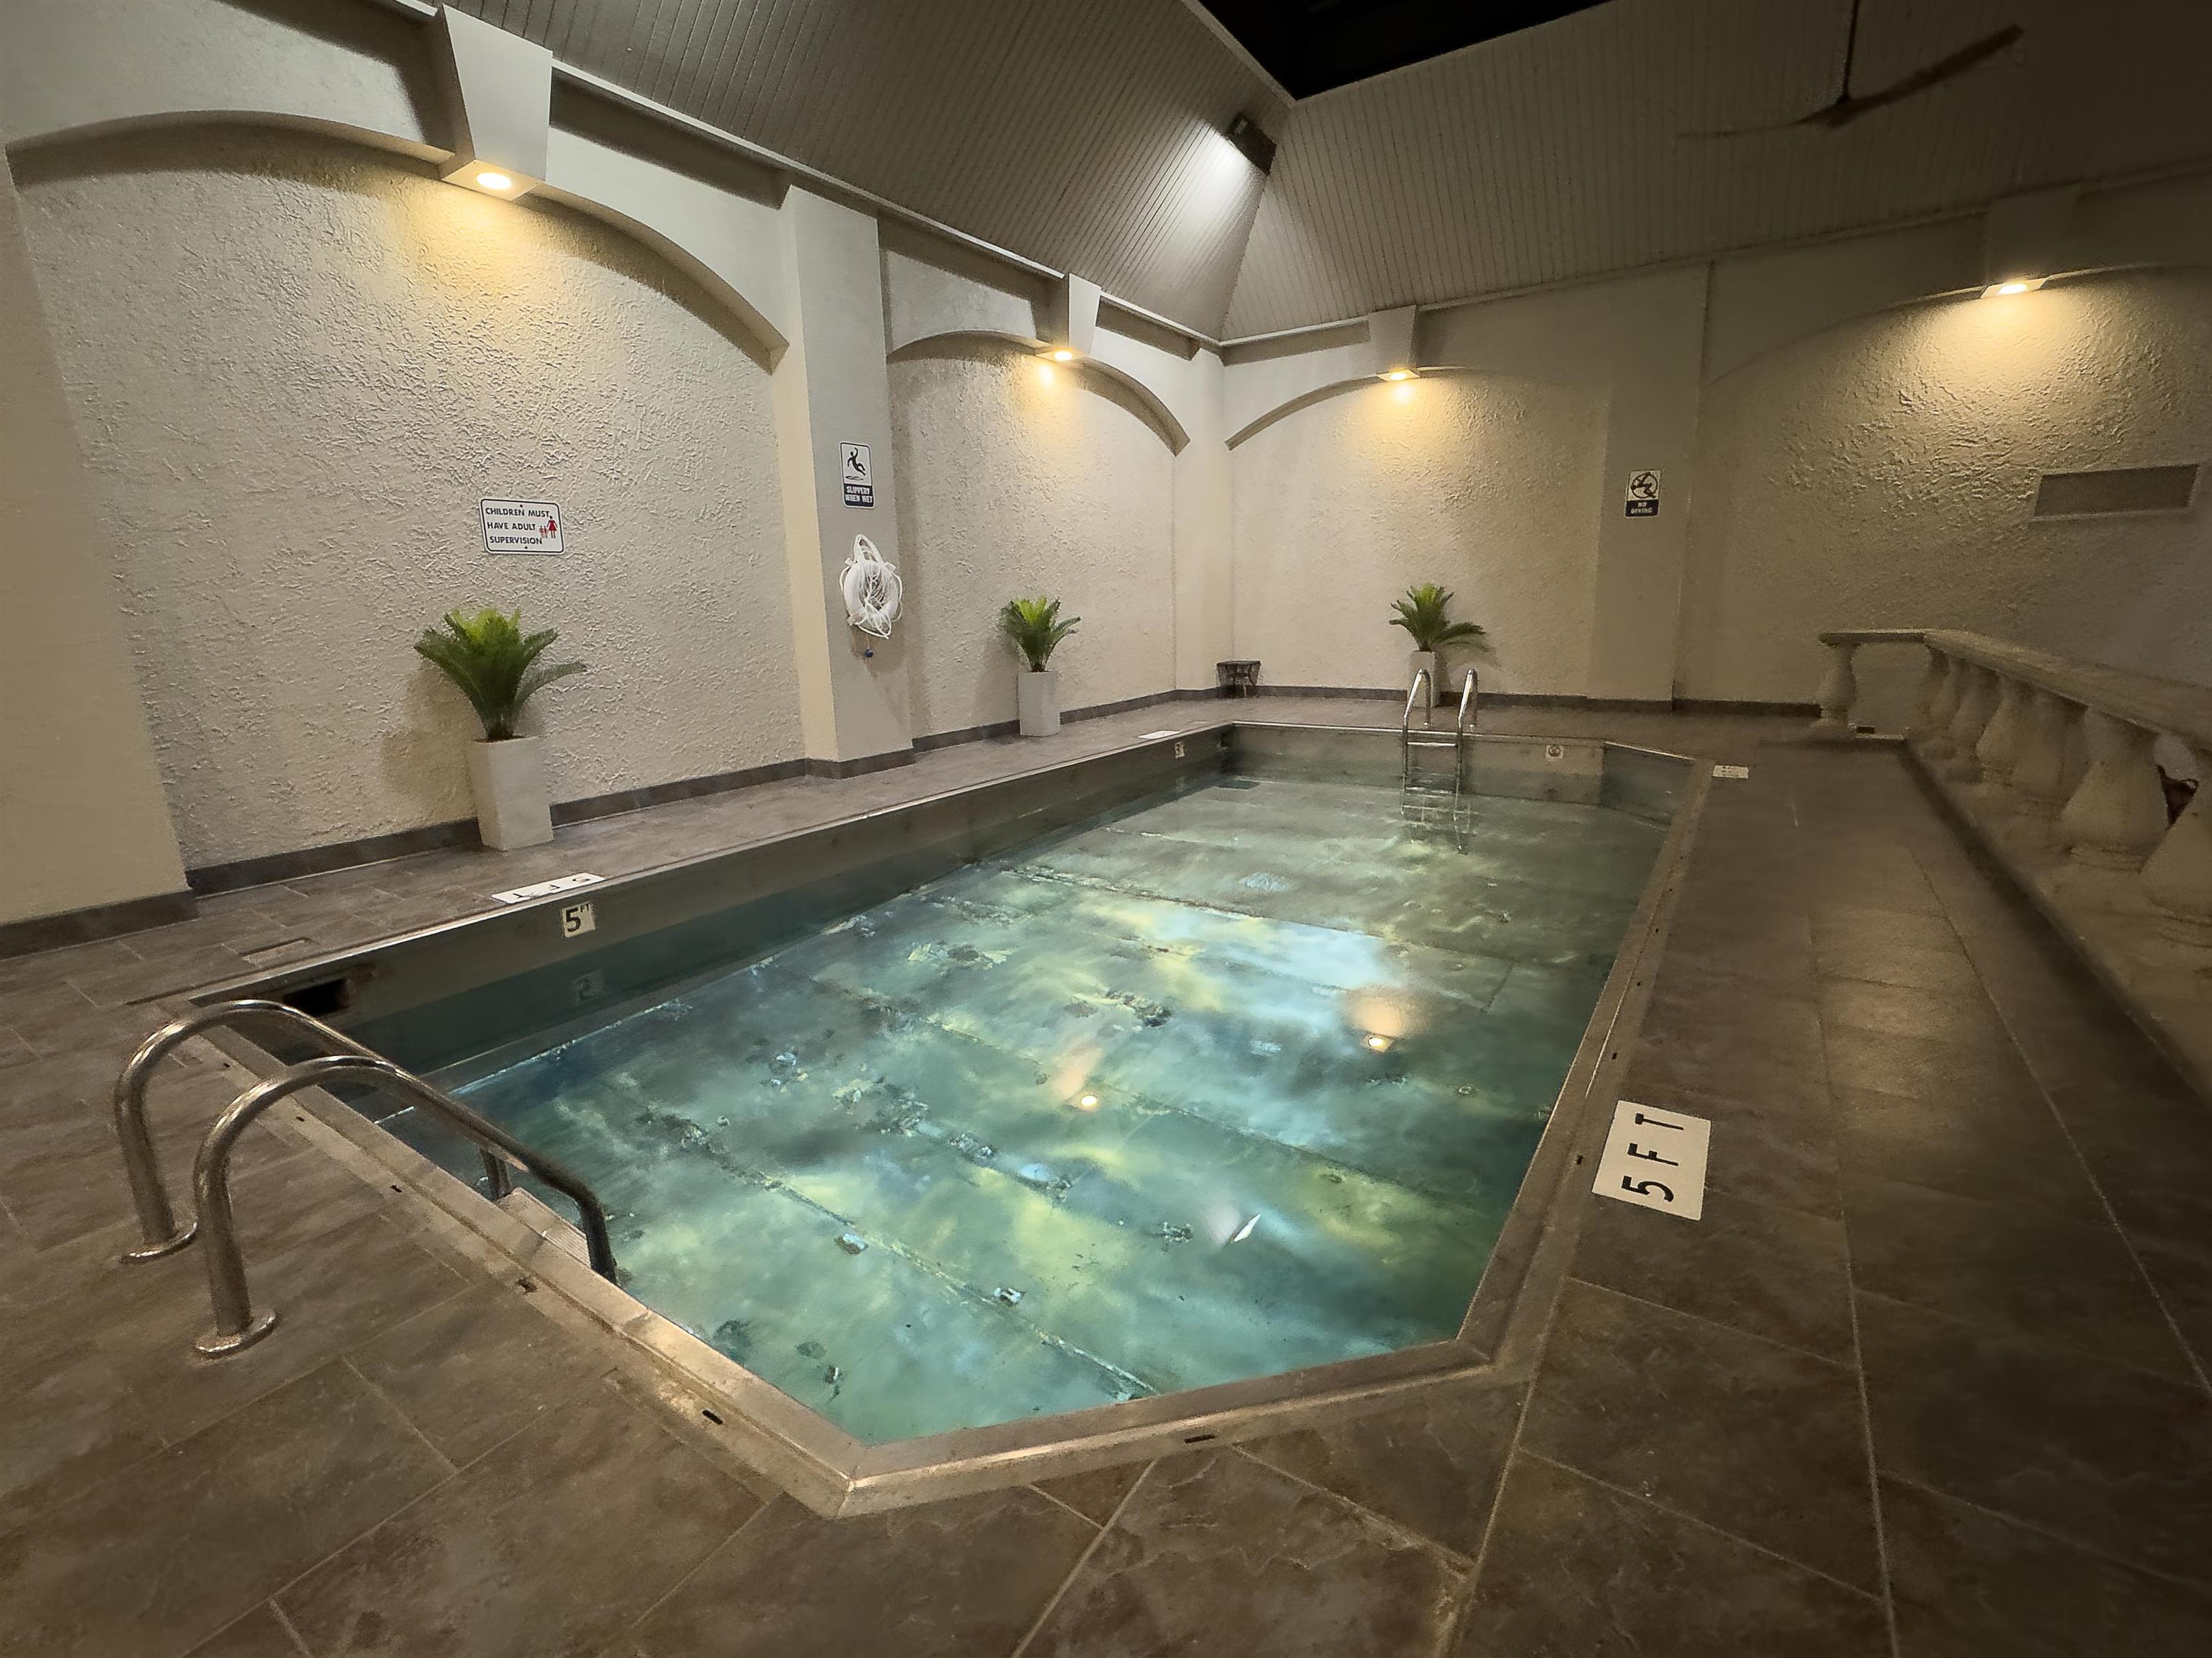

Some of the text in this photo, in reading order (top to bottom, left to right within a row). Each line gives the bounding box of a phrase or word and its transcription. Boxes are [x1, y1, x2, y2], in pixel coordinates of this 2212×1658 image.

[485, 508, 525, 516] CHILDREN
[565, 907, 581, 933] 5
[1621, 1175, 1674, 1202] 5
